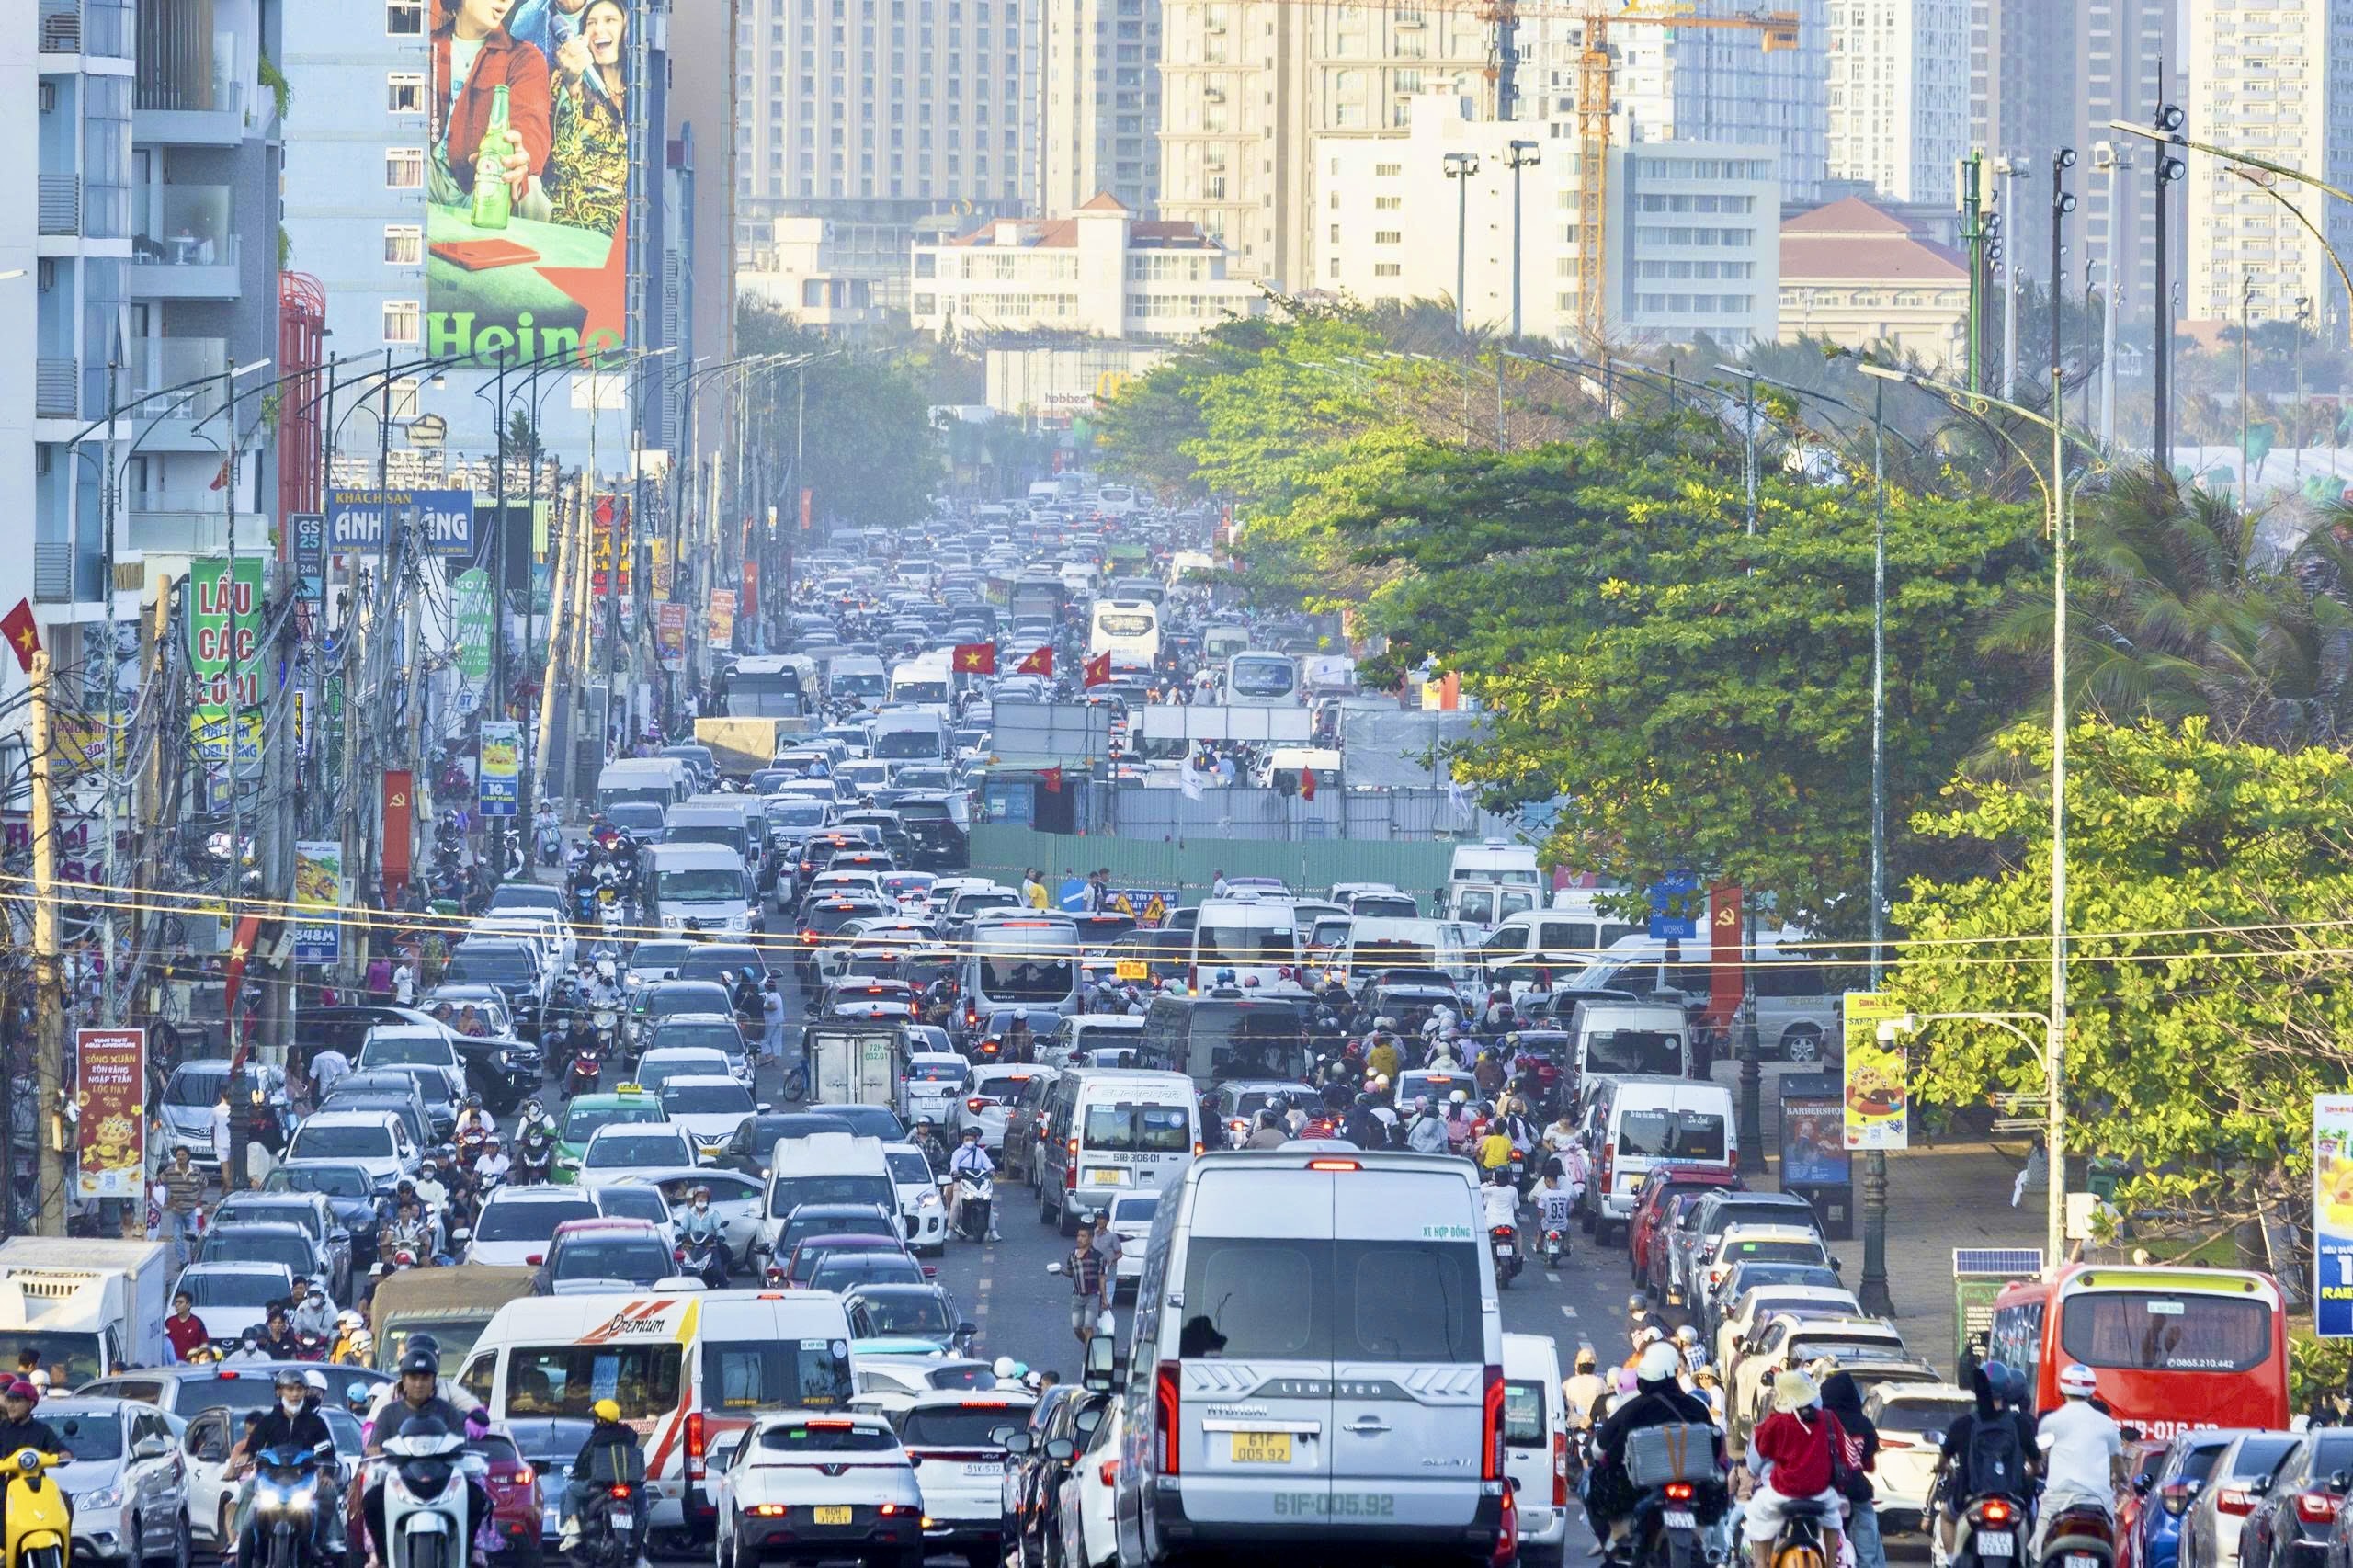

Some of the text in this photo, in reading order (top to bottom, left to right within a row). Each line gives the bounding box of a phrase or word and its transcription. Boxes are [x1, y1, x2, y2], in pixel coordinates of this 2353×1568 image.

[1044, 392, 1087, 404] hobbee
[335, 491, 381, 504] KHÁCH
[299, 521, 319, 533] GS
[335, 505, 381, 542] ÁNH
[299, 535, 319, 548] 25
[300, 564, 317, 574] 24h
[199, 622, 254, 662] CÁC
[296, 929, 335, 942] 348M
[1663, 925, 1684, 935] WORKS
[1551, 1202, 1564, 1219] 93
[1423, 1227, 1432, 1237] XE
[610, 1312, 665, 1341] Premium
[1281, 1380, 1381, 1393] LIMITED
[1207, 1404, 1267, 1416] HYUNDAI
[1248, 1434, 1274, 1448] 61F
[1238, 1449, 1285, 1461] 005.92
[1274, 1494, 1394, 1516] 61F-005.92
